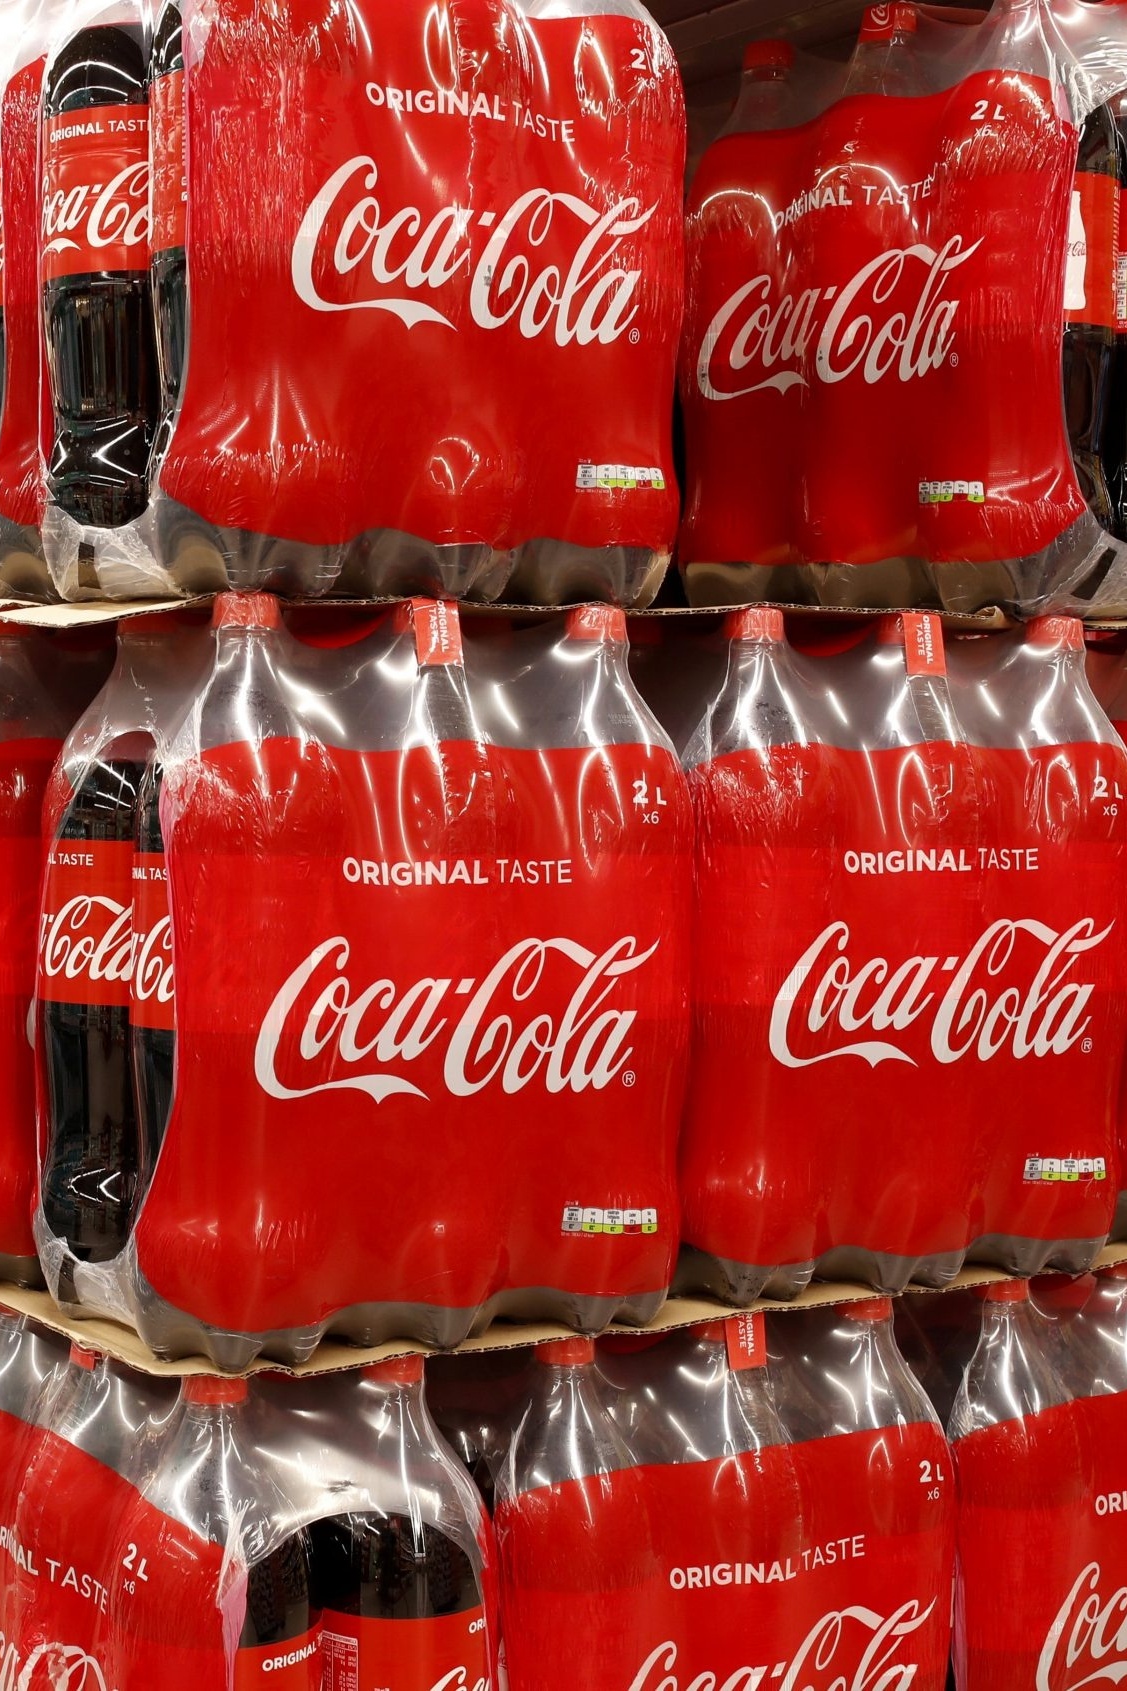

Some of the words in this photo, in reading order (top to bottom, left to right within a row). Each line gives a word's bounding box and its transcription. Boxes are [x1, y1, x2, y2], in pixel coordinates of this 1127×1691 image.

[50, 121, 104, 143] ORIGINAL
[108, 119, 150, 133] TAST
[366, 82, 506, 121] ORIGINAL
[513, 101, 575, 143] TASTE
[774, 186, 853, 231] ORIGINAL
[861, 176, 935, 205] TASTE
[291, 155, 661, 348] Coca-Cola
[697, 234, 986, 401] Coca-Cola
[436, 600, 450, 653] ORIGINAL
[916, 623, 926, 656] TASTE
[922, 615, 934, 665] ORIGINAL
[642, 810, 660, 825] x6
[1102, 803, 1118, 817] x6
[57, 853, 94, 866] TASTE
[342, 857, 489, 886] ORIGINAL
[496, 858, 572, 884] TASTE
[844, 849, 972, 874] ORIGINAL
[978, 847, 1039, 871] TASTE
[769, 917, 1116, 1069] Coca-Cola
[254, 935, 661, 1104] Coca-Cola
[927, 1486, 940, 1501] x6
[669, 1558, 797, 1590] ORIGINAL
[801, 1534, 866, 1572] TASTE
[45, 1557, 109, 1615] TASTE
[122, 1578, 136, 1596] x6
[262, 1640, 317, 1672] ORIGINAL
